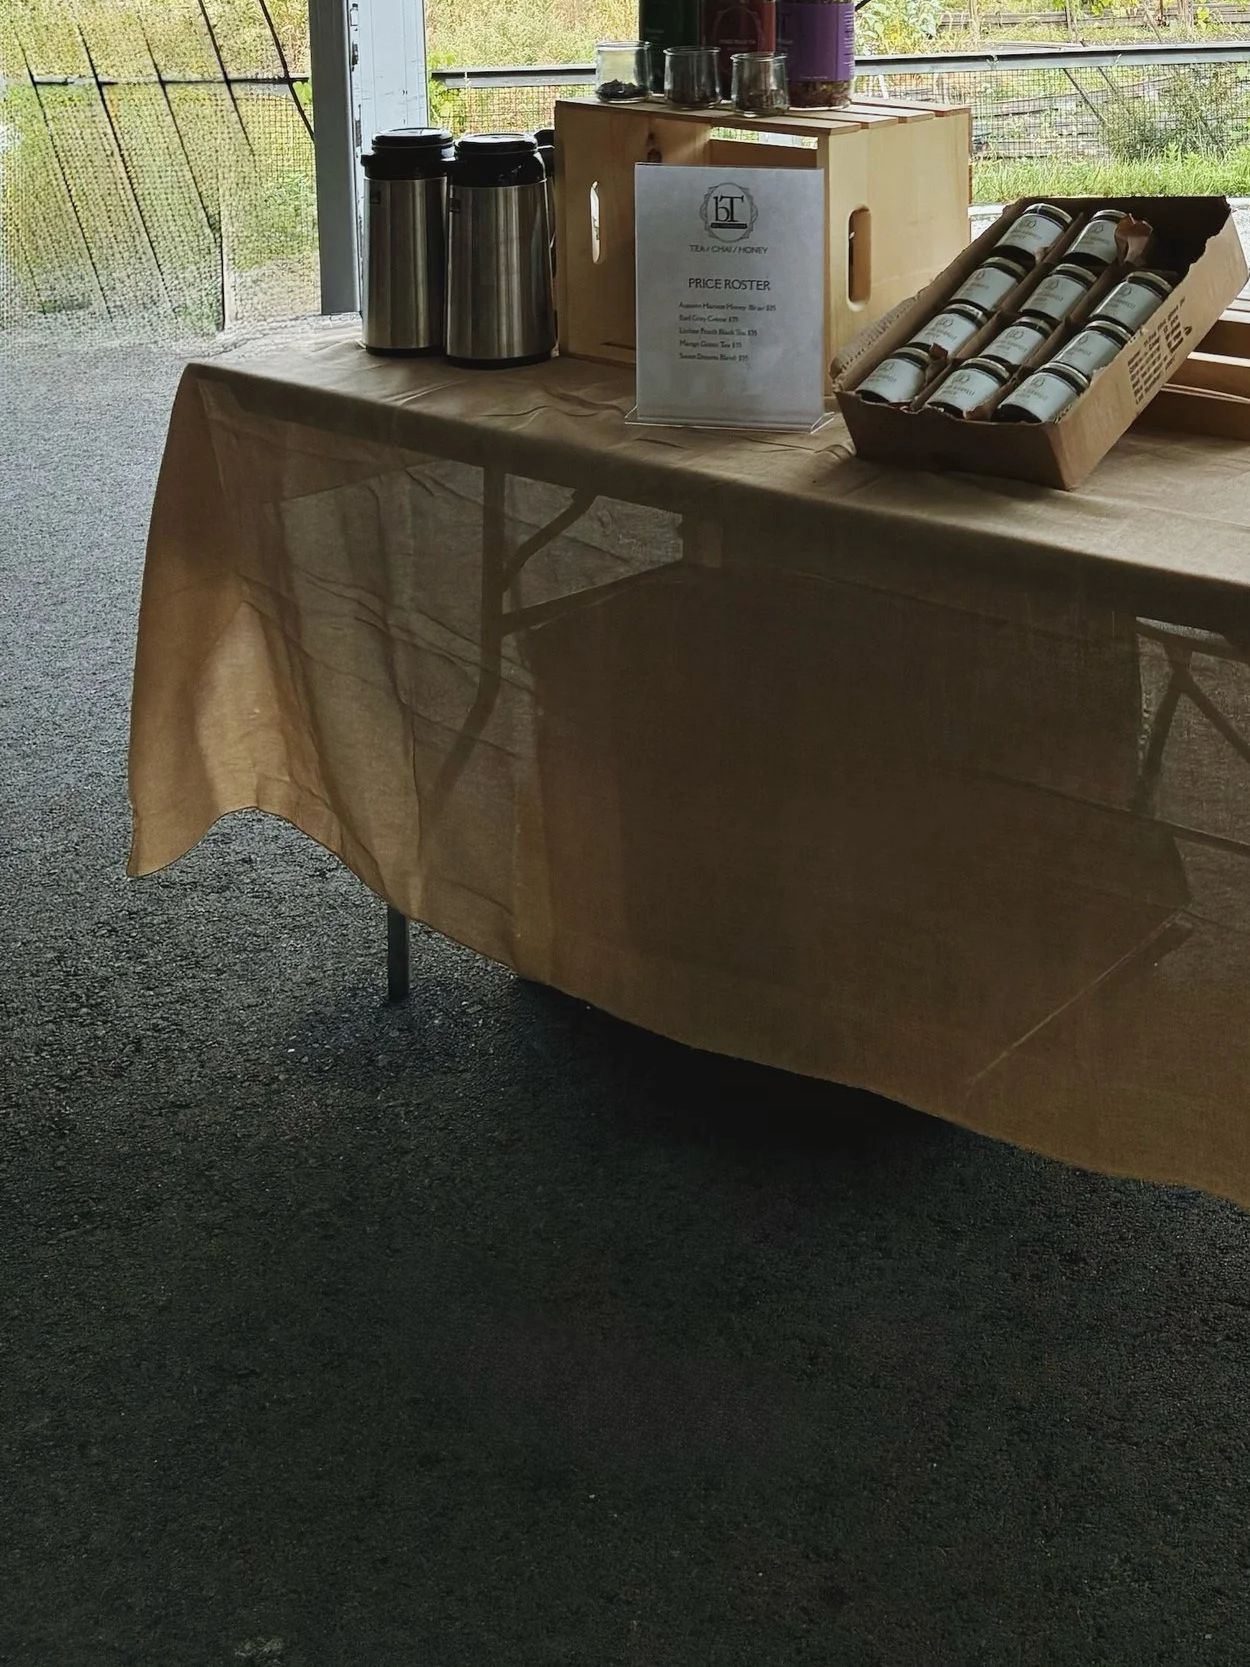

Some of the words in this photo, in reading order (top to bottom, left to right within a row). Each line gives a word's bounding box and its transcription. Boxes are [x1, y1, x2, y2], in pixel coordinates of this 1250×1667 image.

[689, 244, 705, 252] TEA
[711, 245, 732, 253] CHAI
[738, 246, 769, 254] HONEY
[688, 277, 722, 290] PRICE
[724, 279, 771, 291] ROSTER
